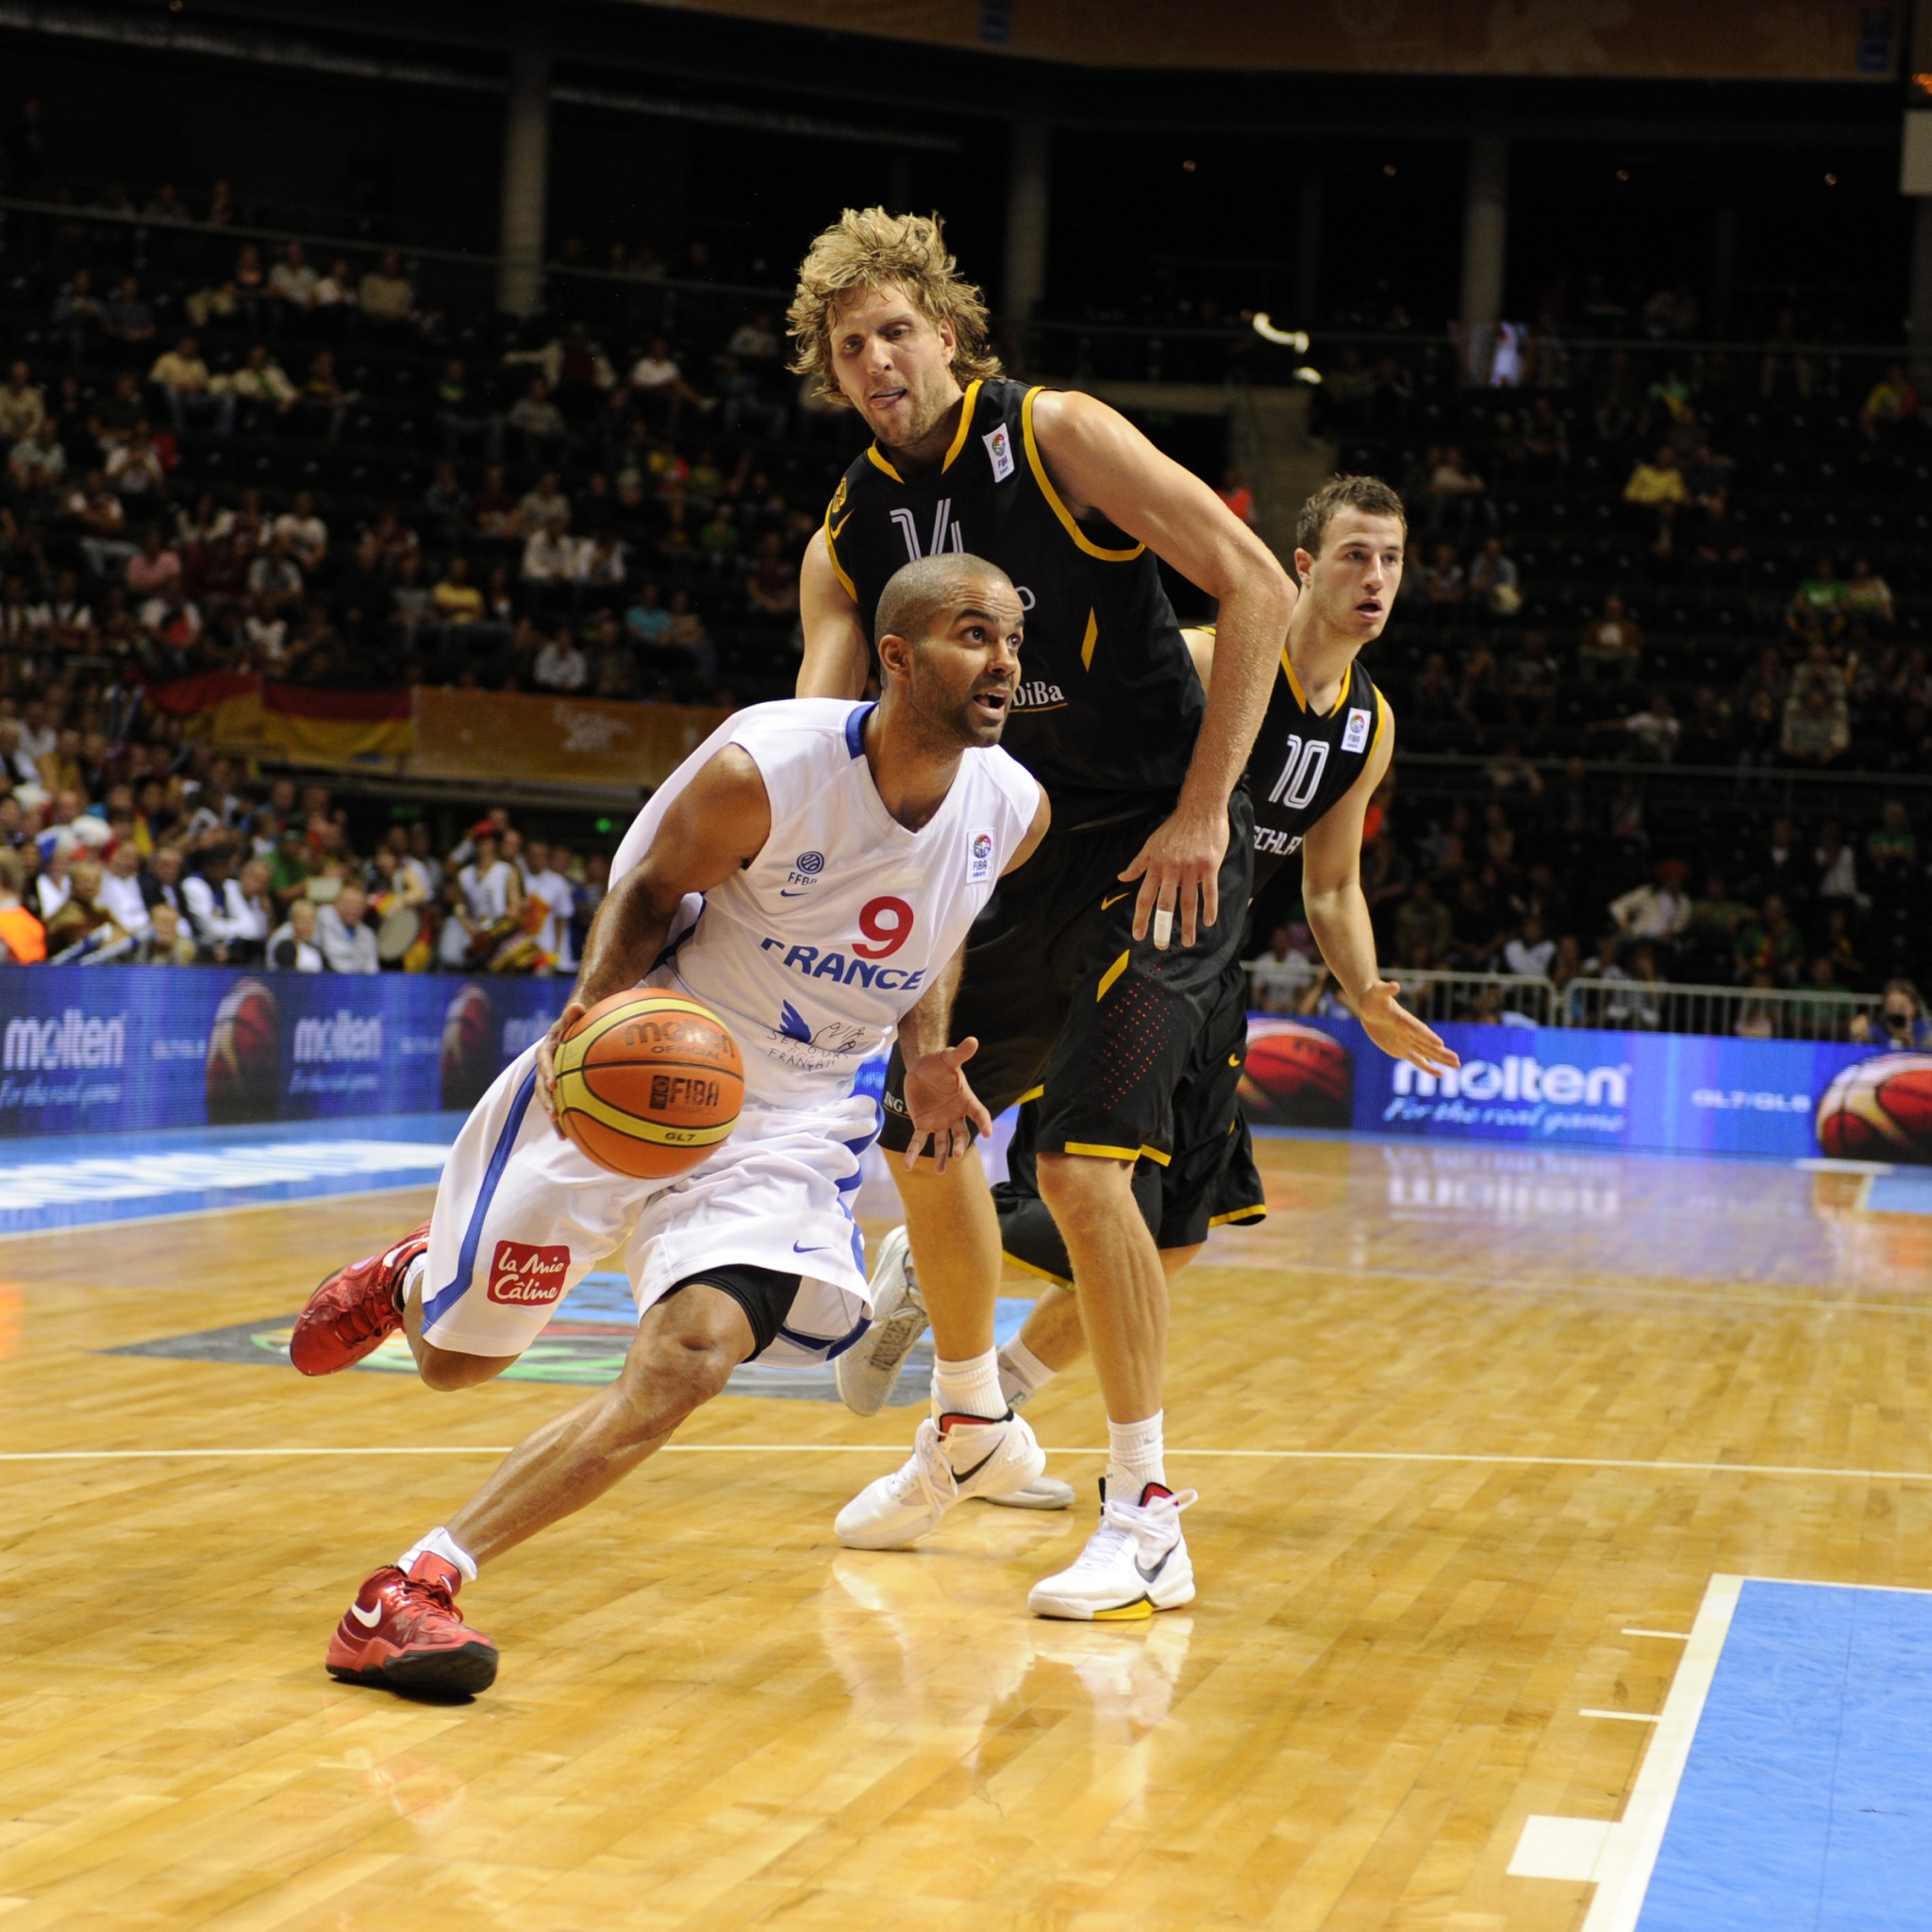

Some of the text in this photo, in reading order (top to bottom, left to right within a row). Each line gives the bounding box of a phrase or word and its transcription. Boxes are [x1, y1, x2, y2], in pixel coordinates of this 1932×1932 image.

[890, 498, 964, 562] 14
[1268, 734, 1329, 810] 10
[973, 860, 988, 871] FIBA
[852, 896, 914, 959] 9
[4, 1008, 125, 1071] molten
[625, 1019, 735, 1058] molten
[651, 1045, 723, 1062] OFFICIAL
[669, 1077, 720, 1107] FIBA
[1393, 1055, 1627, 1108] molten
[665, 1133, 696, 1142] GL7
[519, 1254, 564, 1274] Mie
[494, 1274, 558, 1300] Câline
